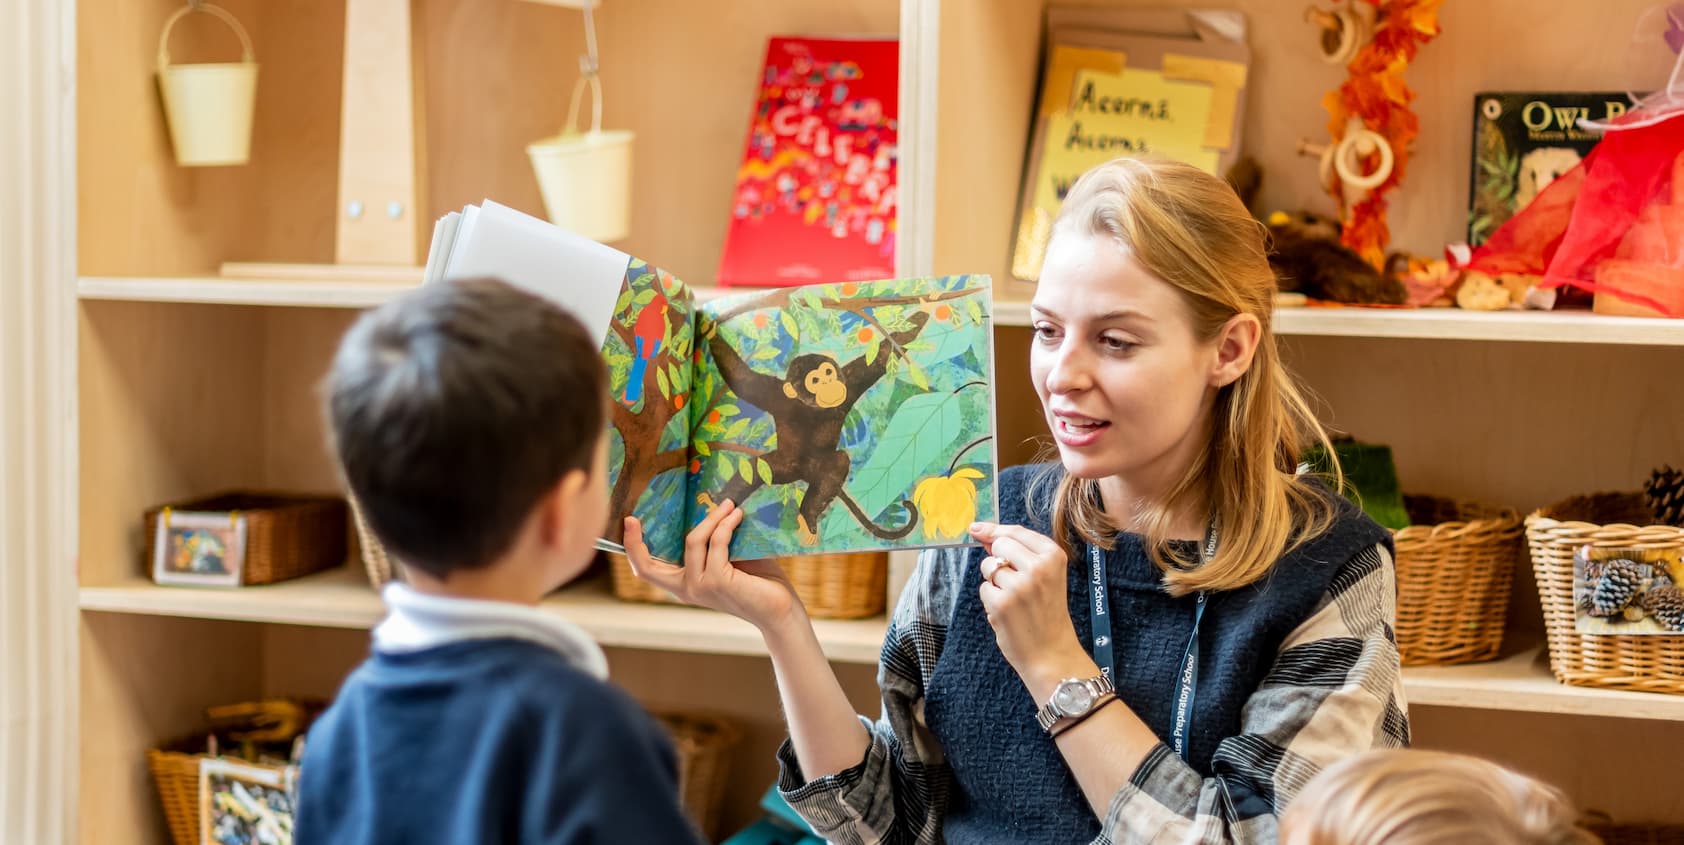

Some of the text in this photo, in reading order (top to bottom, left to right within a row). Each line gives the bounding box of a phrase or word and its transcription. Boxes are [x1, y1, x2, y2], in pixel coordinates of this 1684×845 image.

[1094, 585, 1105, 616] School
[1182, 653, 1194, 684] School
[1174, 684, 1192, 737] Preparatory
